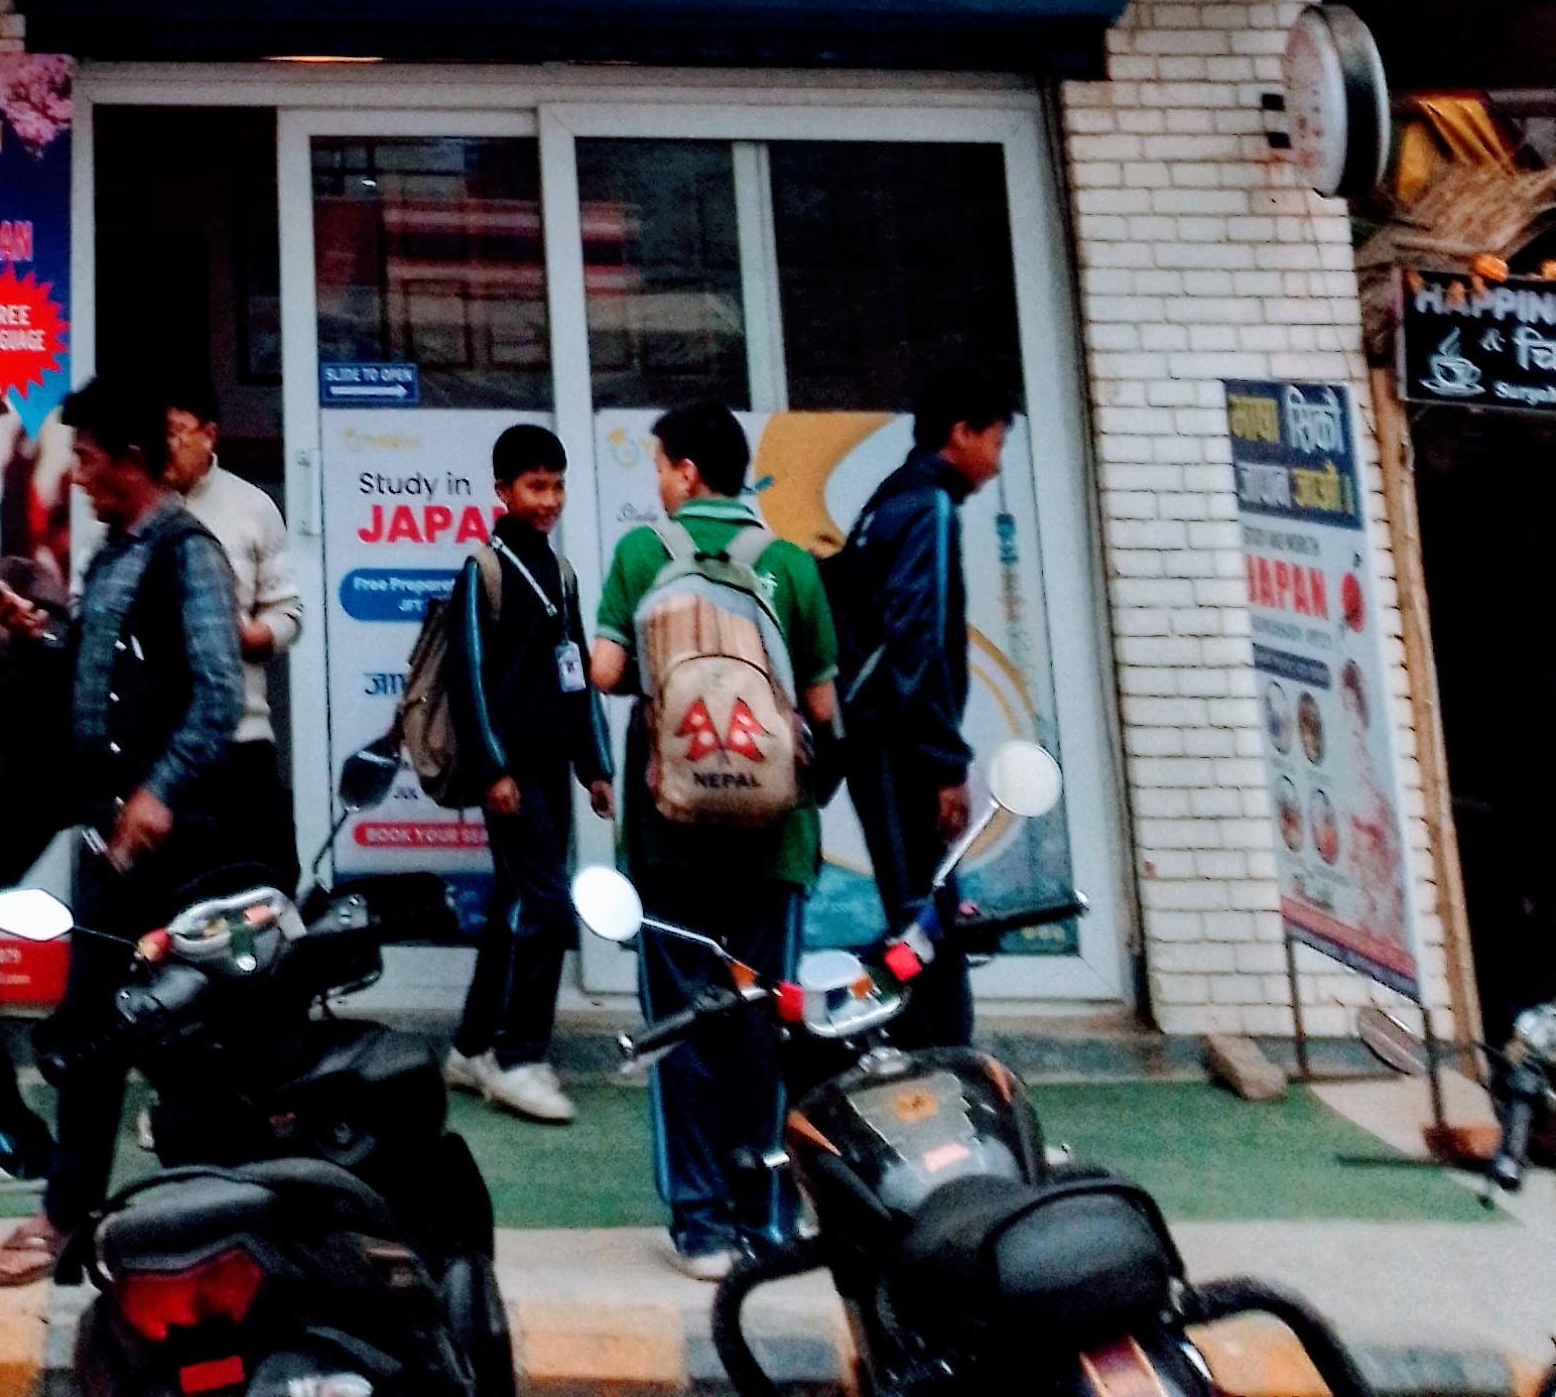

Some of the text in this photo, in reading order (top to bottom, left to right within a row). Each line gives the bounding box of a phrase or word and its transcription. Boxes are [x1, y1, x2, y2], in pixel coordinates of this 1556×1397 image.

[359, 471, 473, 502] Study in
[693, 771, 762, 790] NEPAL
